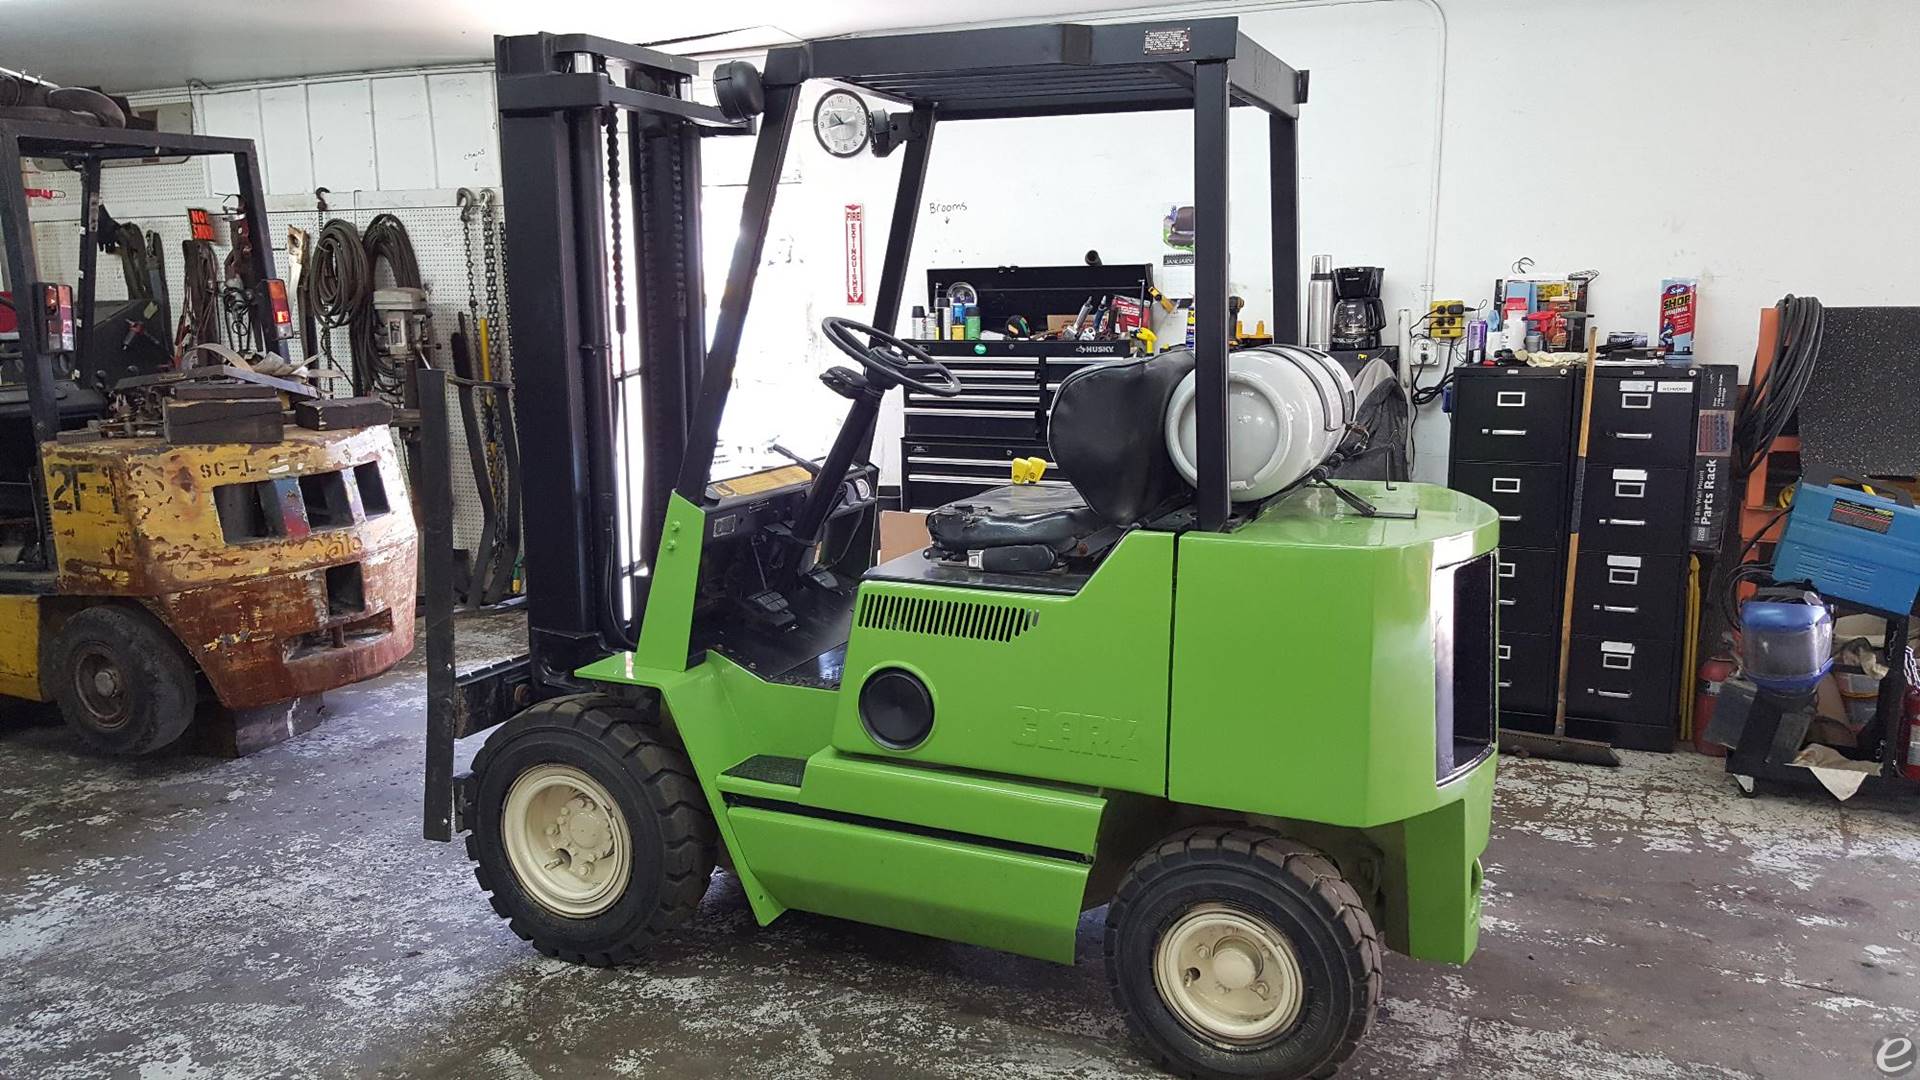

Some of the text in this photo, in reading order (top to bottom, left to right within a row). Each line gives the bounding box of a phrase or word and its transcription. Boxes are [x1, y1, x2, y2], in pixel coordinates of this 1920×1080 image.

[846, 211, 861, 222] FIRE
[929, 202, 968, 214] Brooms
[850, 222, 858, 299] EXTINGUISHER
[1663, 294, 1691, 311] SHOP
[1085, 345, 1115, 353] HUSKY
[1697, 470, 1705, 490] Mount
[1703, 458, 1718, 490] Rack
[1700, 492, 1714, 525] Parts
[1011, 704, 1139, 762] CLARK
